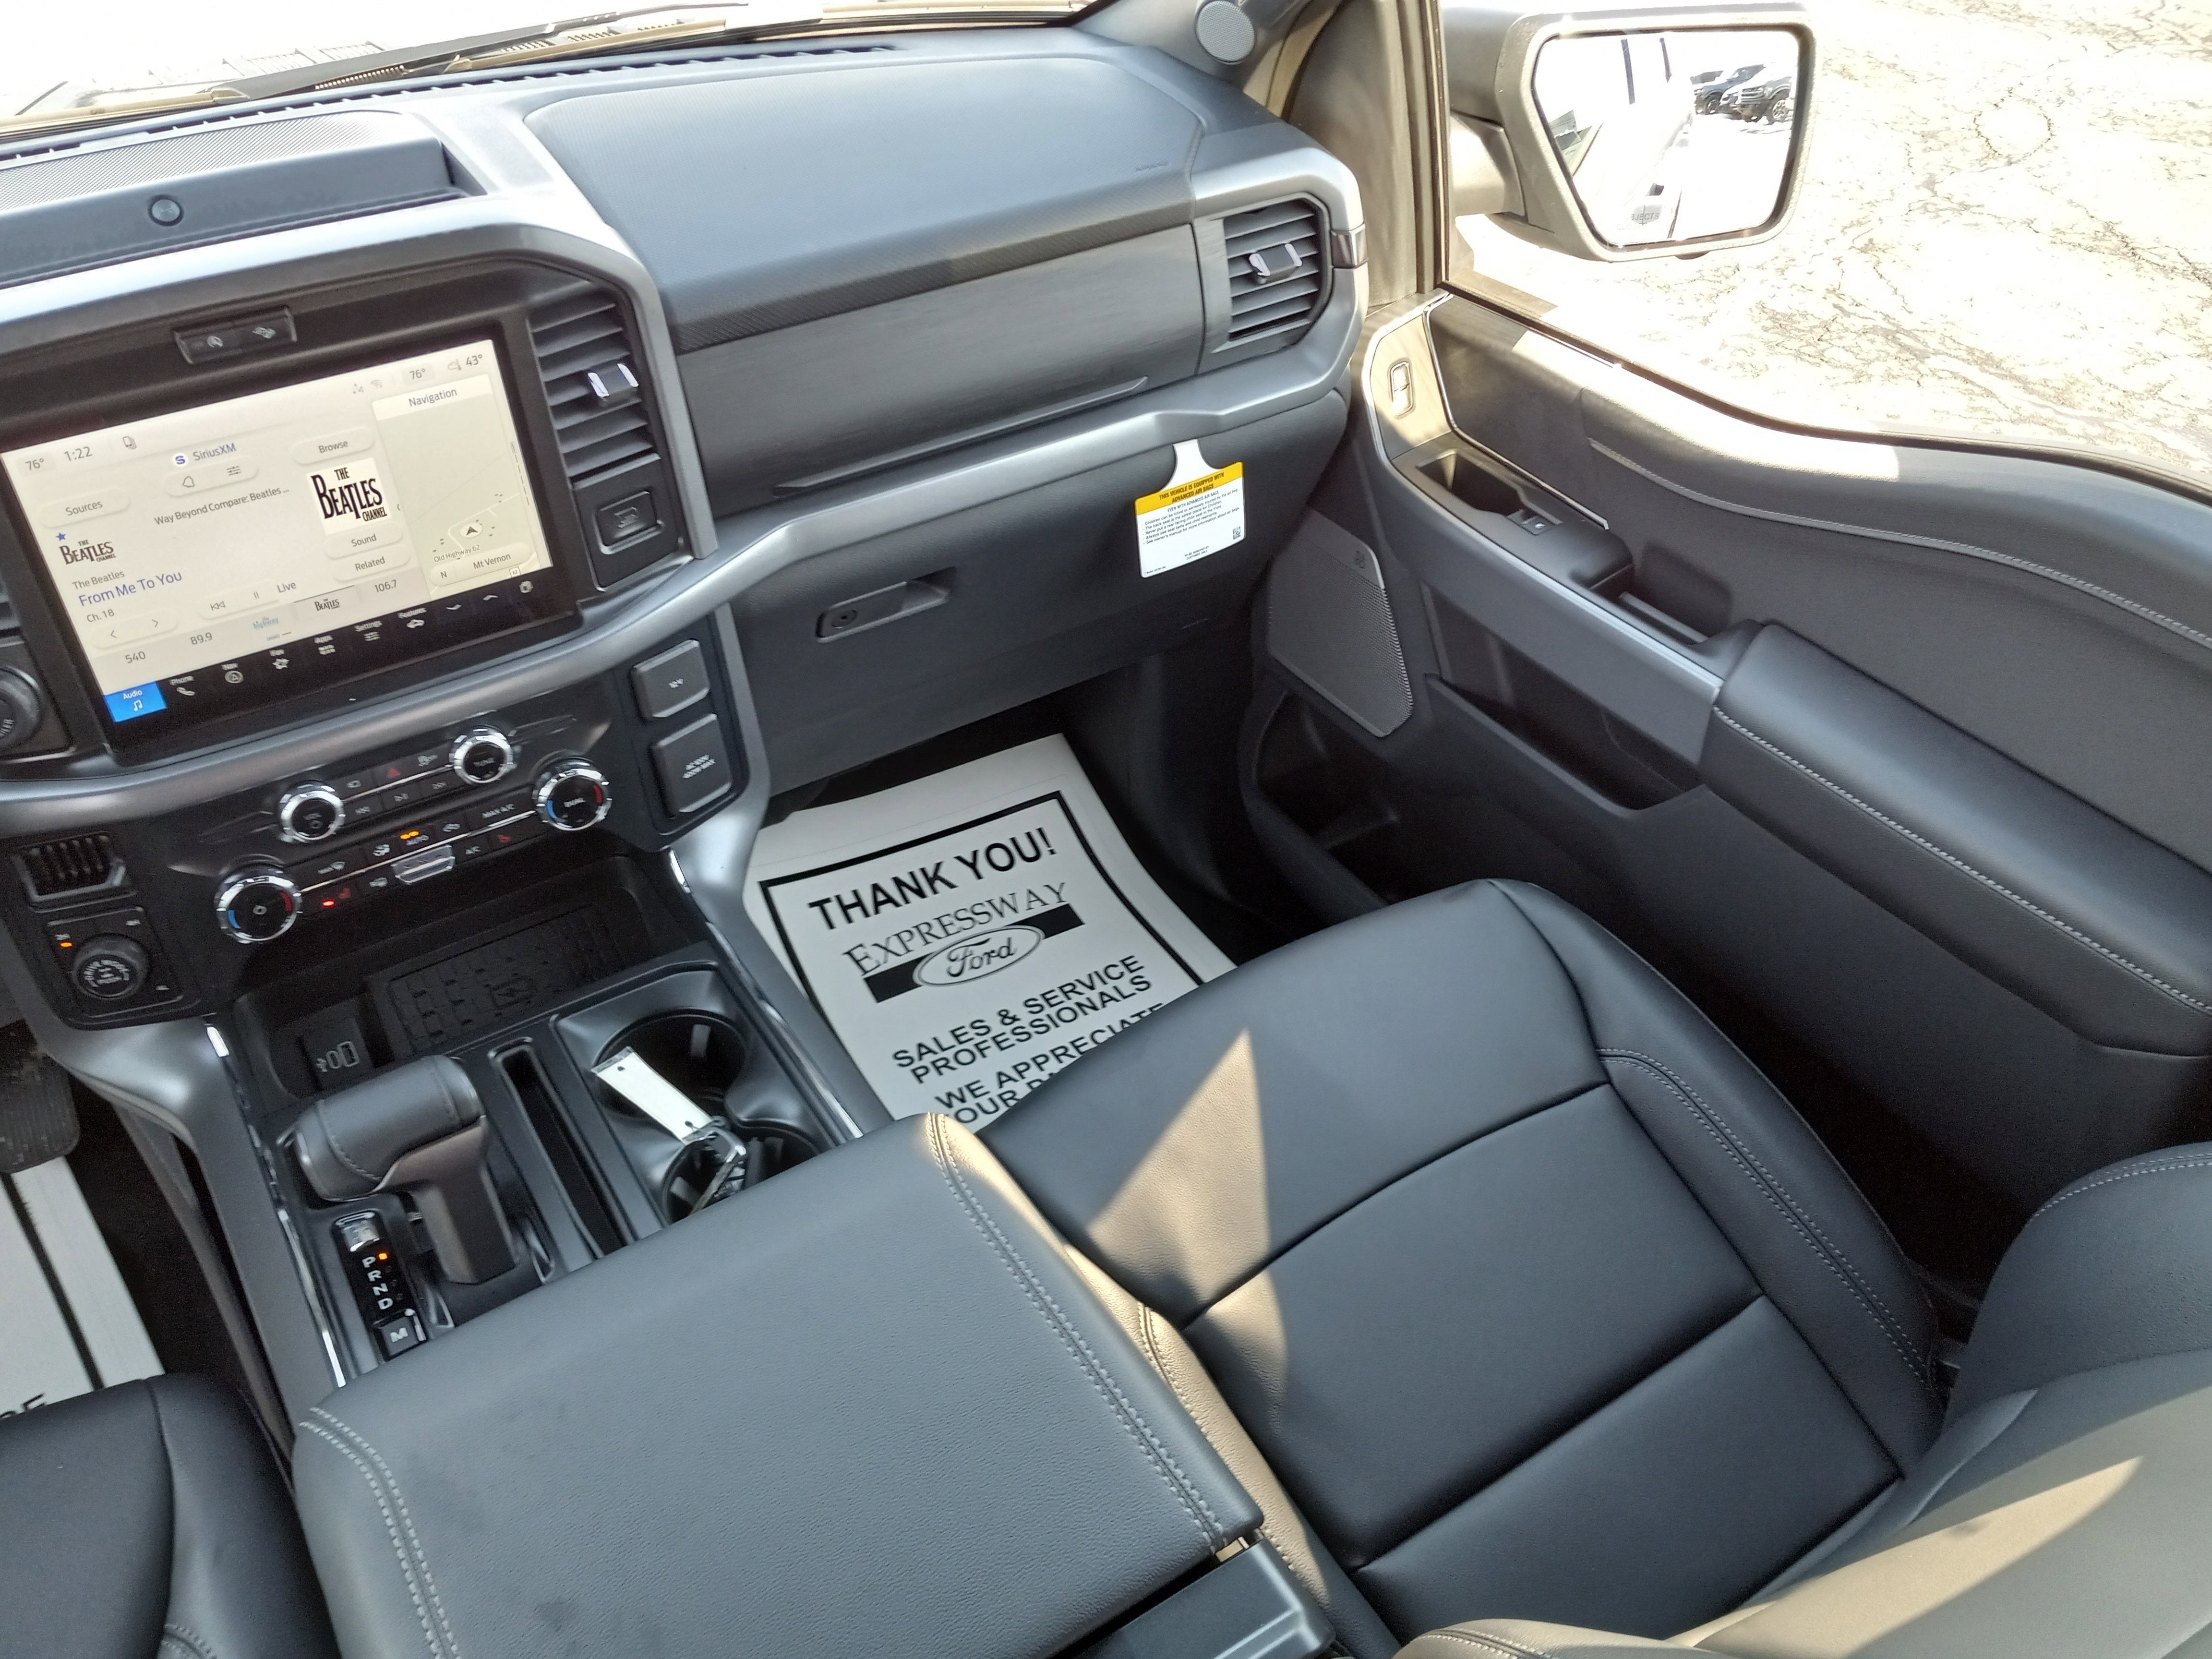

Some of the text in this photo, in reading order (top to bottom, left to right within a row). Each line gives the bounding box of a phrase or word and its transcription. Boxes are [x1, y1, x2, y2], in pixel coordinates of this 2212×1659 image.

[466, 354, 483, 367] 43°
[409, 369, 426, 380] 76°
[409, 388, 458, 407] Navigation
[64, 446, 93, 462] 1:22
[192, 443, 237, 461] SiriusXM
[318, 440, 349, 454] Browse
[25, 458, 45, 471] 76°
[334, 468, 349, 481] THE
[1170, 485, 1188, 496] VEHICLE
[1194, 477, 1214, 488] EQUIPPED
[1214, 472, 1224, 481] WITH
[310, 473, 384, 521] BEATLES
[1172, 491, 1194, 504] ADVANCED
[1203, 483, 1214, 493] BAGS
[66, 500, 103, 516] Sources
[154, 514, 174, 526] Way
[176, 505, 208, 521] Beyond
[209, 495, 249, 512] Compare:
[250, 487, 281, 502] Beatles
[1187, 497, 1203, 506] ADVANCED
[362, 506, 388, 522] CHANNEL
[351, 534, 377, 547] Sound
[59, 541, 114, 565] BEATLES
[445, 548, 472, 559] Highway
[355, 556, 385, 571] Related
[473, 554, 511, 570] Mt Vernon
[72, 570, 125, 590] The Beatles
[441, 570, 447, 579] N
[79, 572, 183, 607] From Me To You
[277, 581, 297, 593] Live
[374, 579, 397, 593] 106.7
[314, 599, 340, 611] BEATLES
[86, 609, 115, 623] Ch. 18
[190, 632, 213, 646] 89.9
[125, 651, 146, 664] 540
[123, 690, 143, 700] Audio
[808, 827, 1058, 930] THANK YOU!
[842, 881, 1071, 976] EXPRESSWAY
[945, 936, 1017, 977] Ford
[892, 955, 1145, 1068] SALES & SERVICE
[910, 973, 1153, 1084] PROFESSIONALS
[934, 1079, 991, 1109] WE
[944, 1089, 1020, 1124] OUR
[362, 1256, 376, 1268] P
[367, 1270, 383, 1282] R
[373, 1283, 389, 1296] N
[378, 1298, 394, 1310] D
[389, 1327, 408, 1343] M
